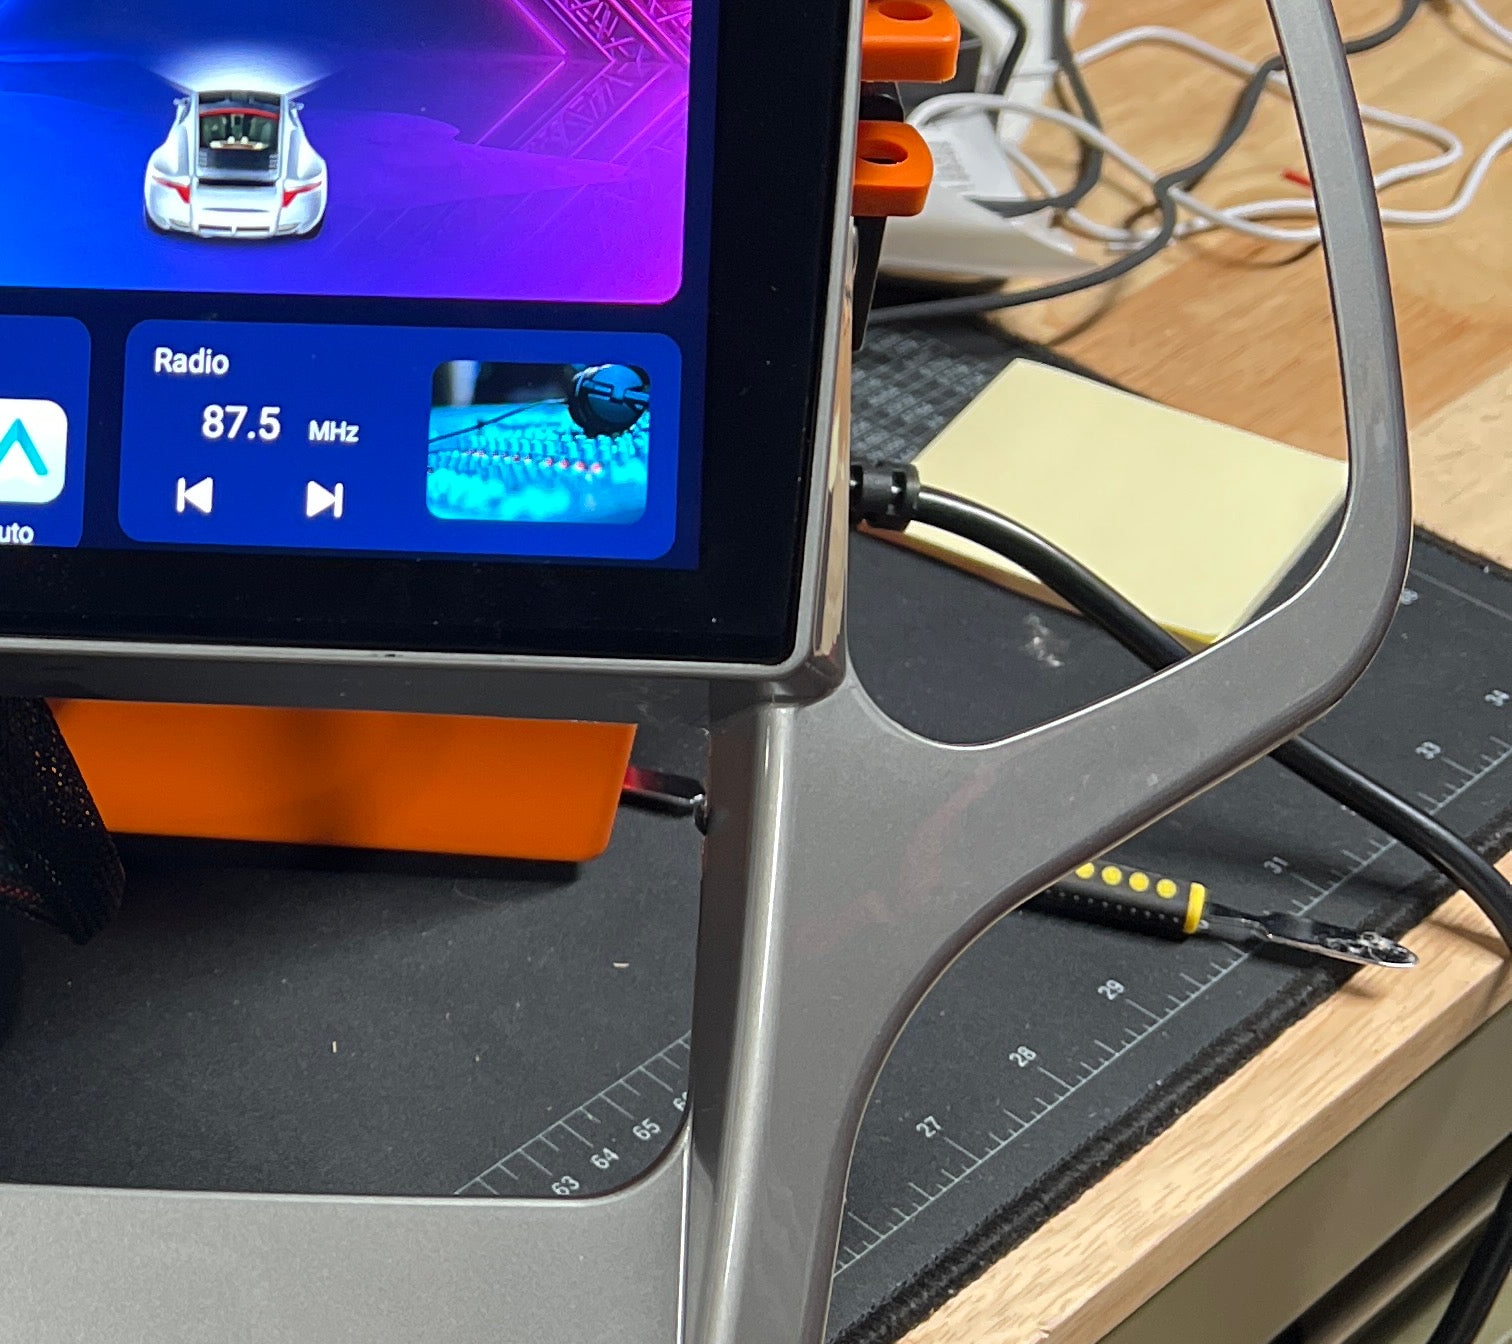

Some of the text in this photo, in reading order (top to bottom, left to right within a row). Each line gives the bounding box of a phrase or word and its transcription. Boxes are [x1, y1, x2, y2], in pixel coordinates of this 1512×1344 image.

[154, 348, 230, 376] Radio
[201, 405, 360, 446] 87.5 MHz
[1097, 979, 1126, 1001] 29
[1009, 1046, 1038, 1068] 28
[632, 1118, 661, 1142] 65
[916, 1115, 942, 1138] 27
[591, 1146, 619, 1172] 64
[552, 1175, 580, 1197] 63
